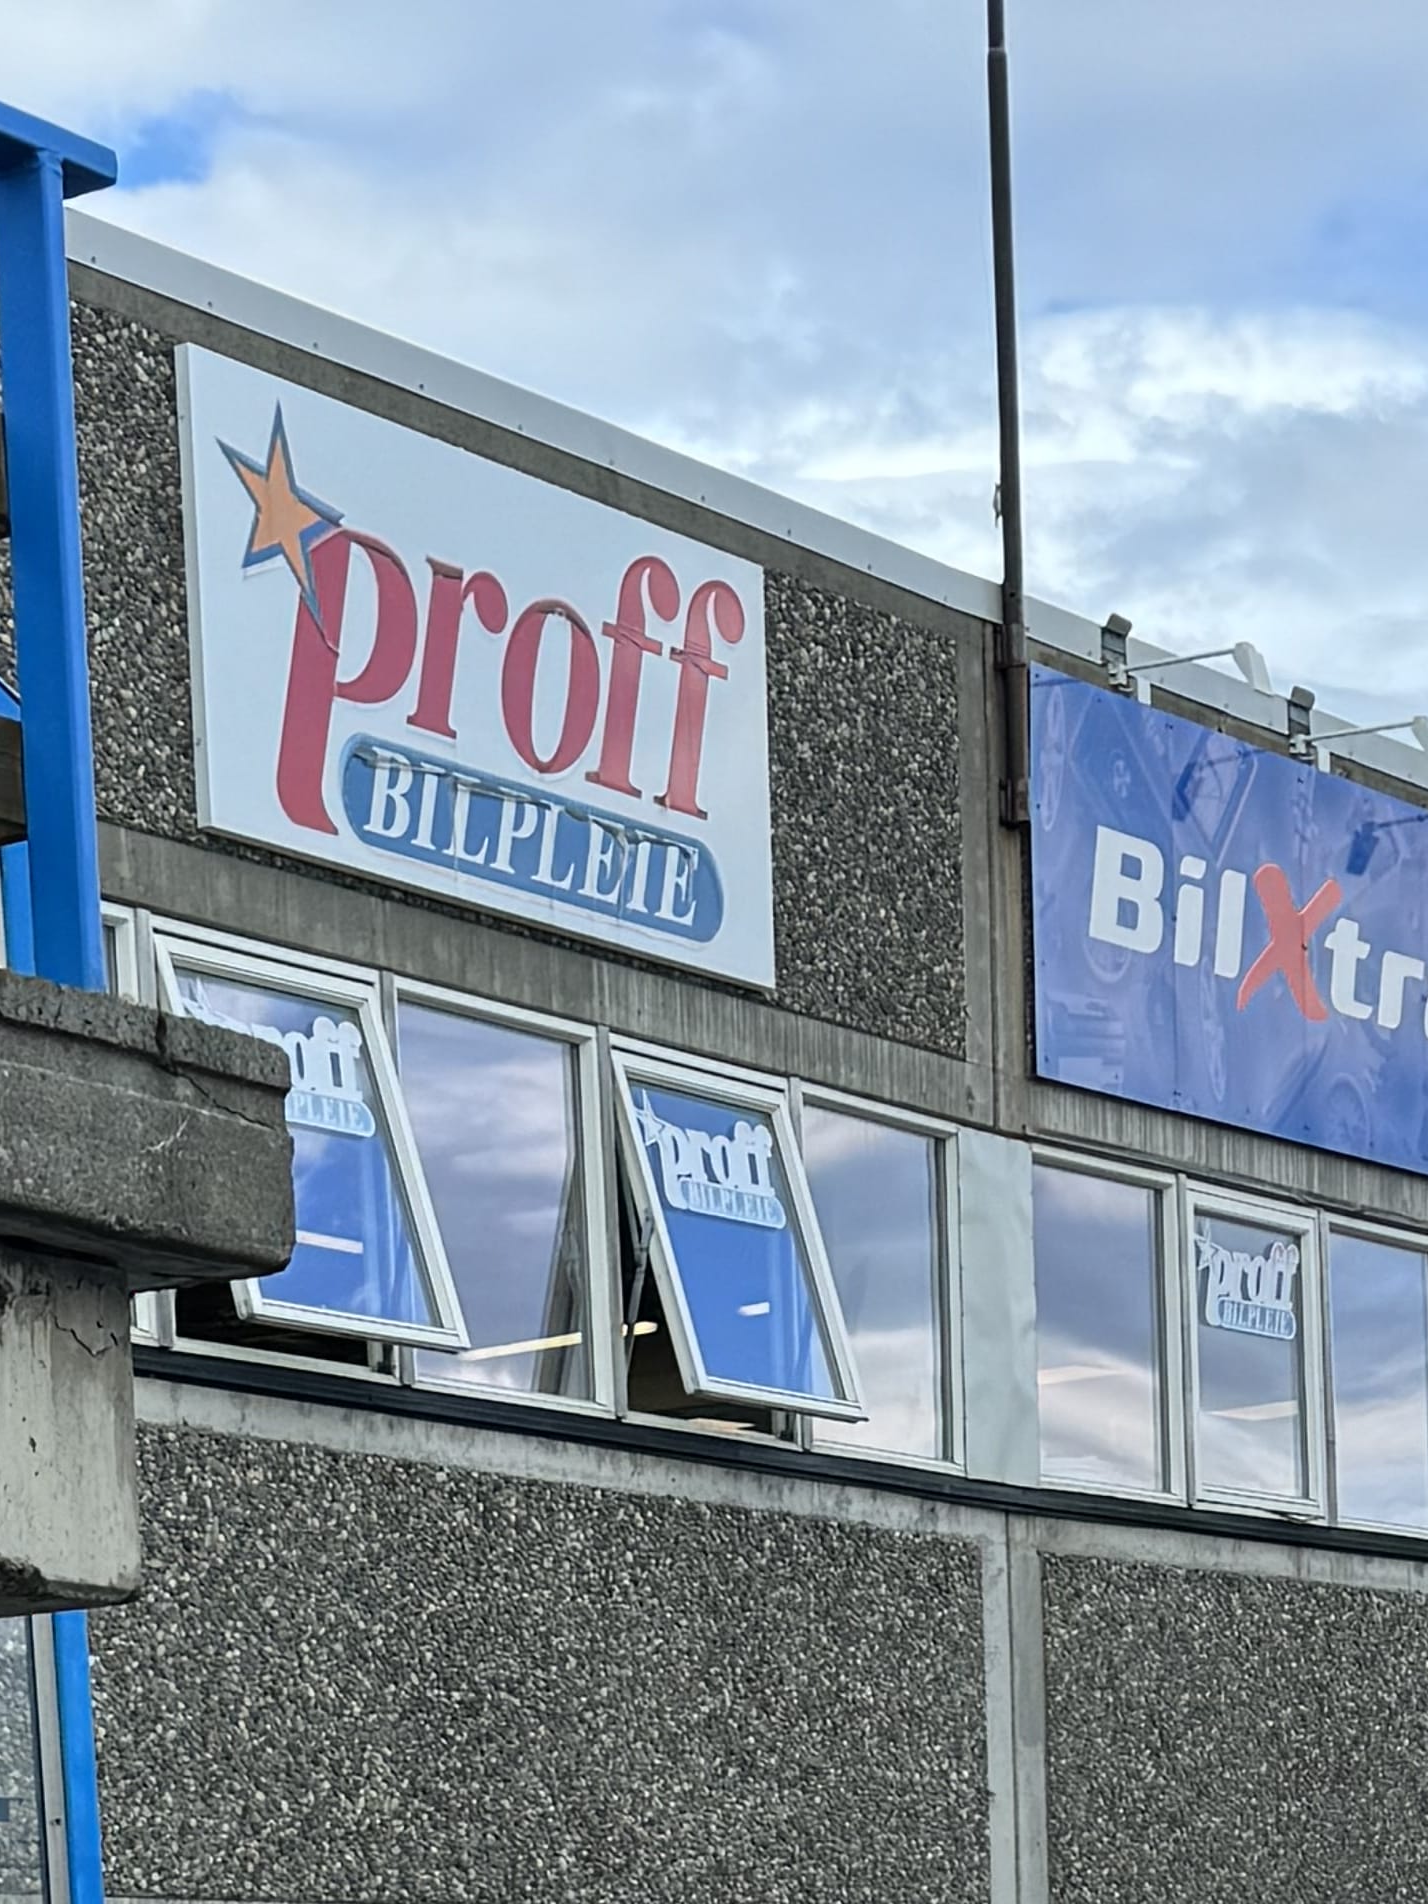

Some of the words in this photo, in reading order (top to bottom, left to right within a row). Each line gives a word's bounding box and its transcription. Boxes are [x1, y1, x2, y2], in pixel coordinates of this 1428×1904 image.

[276, 527, 746, 836] proff
[363, 748, 700, 927] BILPLEIE
[296, 1098, 365, 1129] PLEIE
